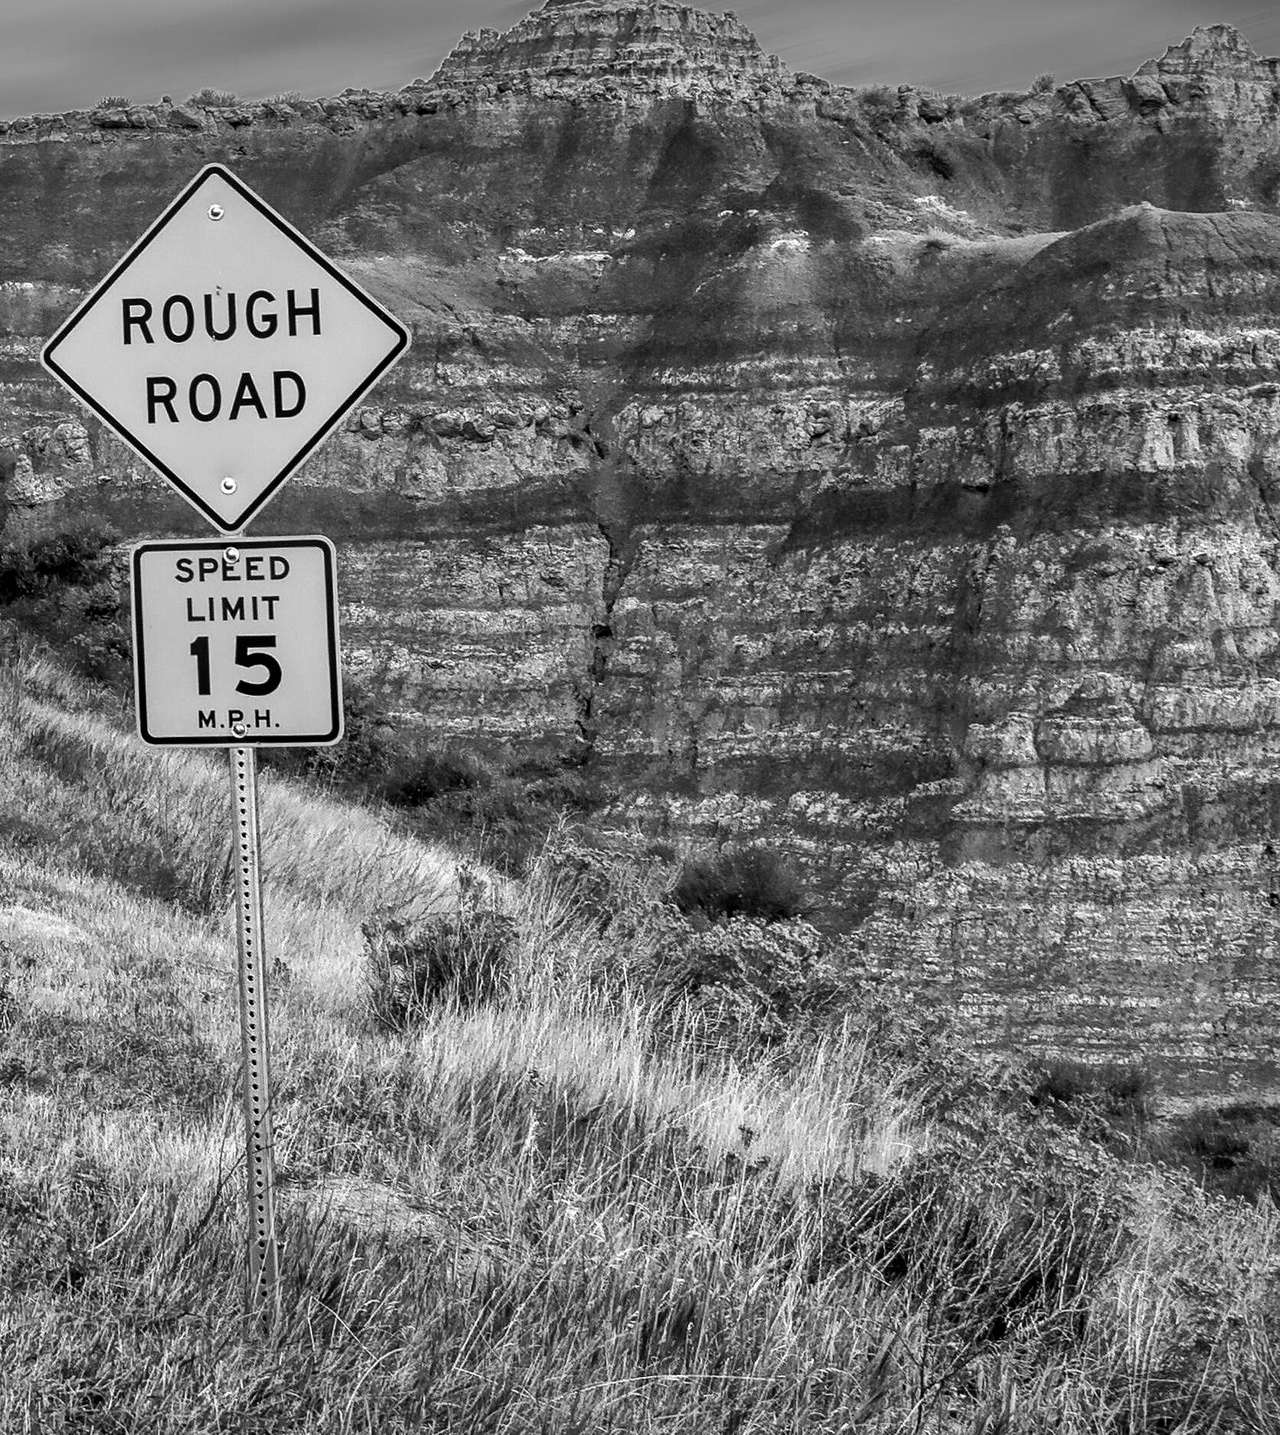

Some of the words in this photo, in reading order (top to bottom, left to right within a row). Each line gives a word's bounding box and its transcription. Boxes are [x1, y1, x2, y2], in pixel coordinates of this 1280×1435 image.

[121, 288, 321, 345] ROUGH
[146, 370, 307, 424] ROAD
[175, 556, 290, 583] SPEED
[186, 596, 280, 622] LIMIT
[190, 635, 282, 696] 15
[198, 709, 280, 729] M.P.H.
